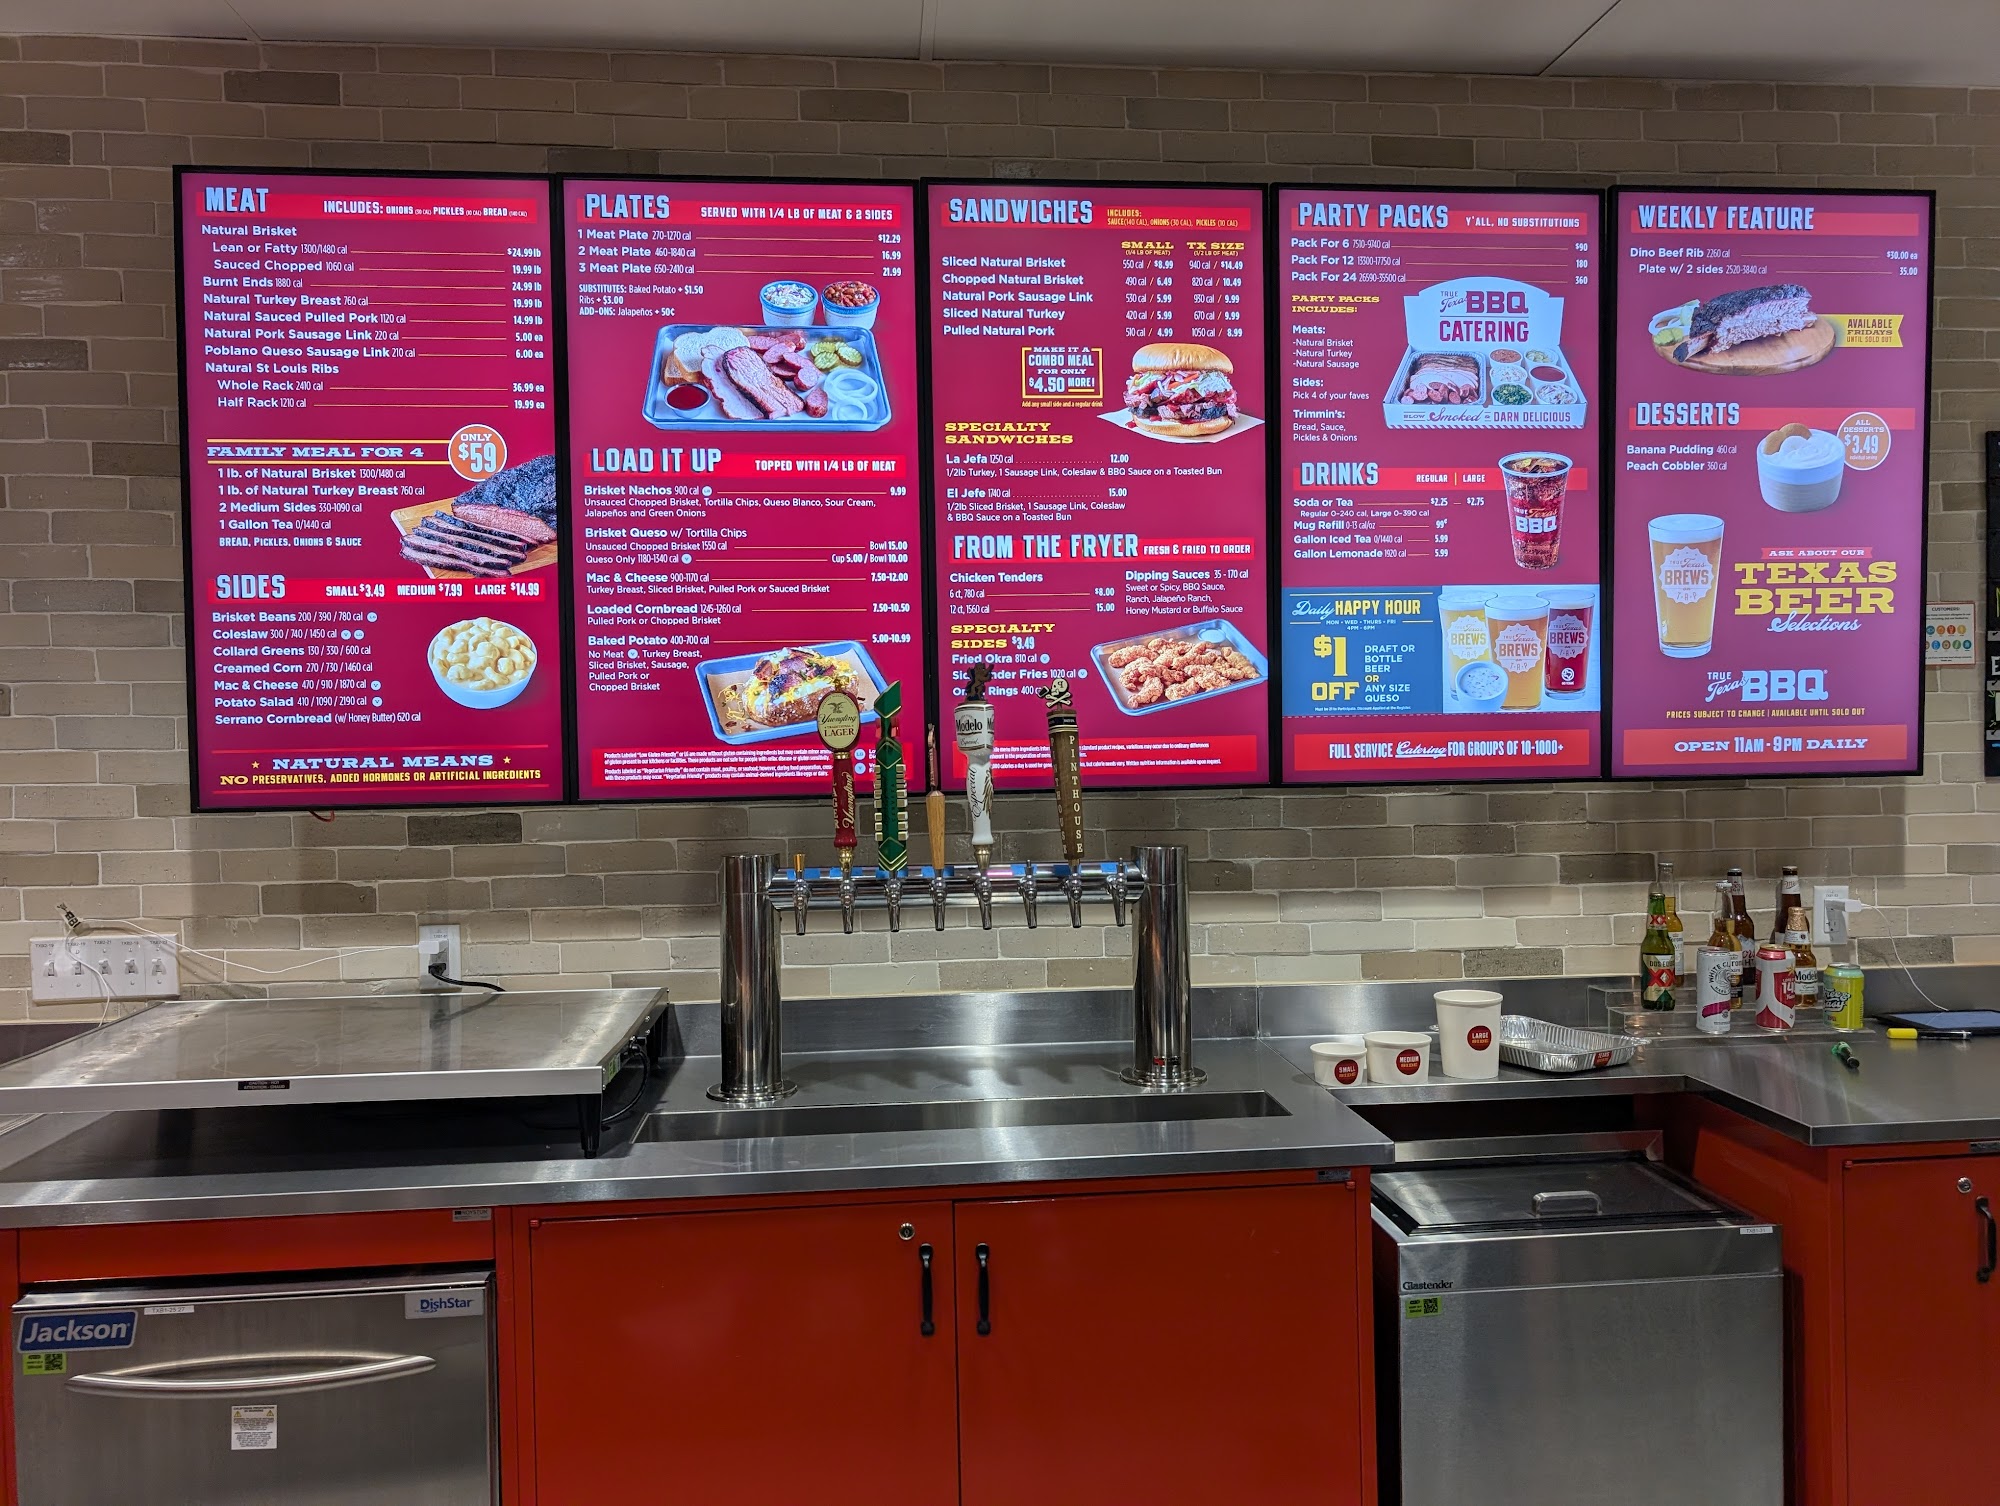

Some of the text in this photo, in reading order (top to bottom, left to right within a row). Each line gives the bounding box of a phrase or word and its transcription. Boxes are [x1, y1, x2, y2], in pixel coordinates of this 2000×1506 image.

[205, 187, 268, 212] MEAT
[585, 194, 670, 219] PLATES
[701, 206, 892, 220] SERVED WITH 1/4 LB OF MEAT & 2 SIDES
[949, 199, 1093, 224] SANDWICHES
[1299, 202, 1448, 228] PARTY PACKS
[1638, 205, 1814, 230] WEEKLY FEATURE
[202, 224, 297, 236] Natural Brisket
[1498, 217, 1509, 227] NO
[1512, 217, 1580, 228] SUBSTITUTIONS
[578, 229, 901, 244] 1 Meat Plate 270-1270 cal $12.29
[1187, 242, 1205, 250] TX
[1211, 242, 1244, 250] SIZE
[1630, 247, 1703, 258] Dino Beef Rib
[1291, 255, 1588, 268] Pack For 12 180
[203, 277, 542, 292] Burnt Ends 1880 cal 24.99 lb
[942, 274, 1083, 286] Chopped Natural Brisket
[1466, 291, 1528, 313] BBQ
[1847, 318, 1892, 329] AVAILABLE
[1440, 321, 1529, 342] CATERING
[1028, 355, 1094, 367] COMBO MEAL
[1029, 377, 1095, 393] $4.50 MORE!
[1494, 411, 1571, 422] DARN DELICIOUS
[1637, 403, 1740, 425] DESSERTS
[945, 423, 1051, 432] SPECIALTY
[461, 434, 492, 442] ONLY
[945, 435, 1073, 444] SANDWICHES
[1844, 434, 1878, 454] $3.49
[208, 447, 424, 458] FAMILY MEAL FOR 4
[458, 442, 496, 472] $59
[1627, 444, 1713, 457] Banana Pudding
[591, 448, 721, 473] LOAD IT UP
[1301, 463, 1379, 486] DRINKS
[1416, 474, 1485, 483] REGULAR LARGE
[584, 485, 906, 496] Brisket Nachos 900 cal 9.99
[954, 534, 1138, 559] FROM THE FRYER
[1144, 544, 1250, 555] FRESH & FRIED TO ORDER
[1734, 561, 1897, 584] TEXAS
[216, 574, 286, 599] SIDES
[326, 583, 539, 597] SMALL $3.49 MEDIUM $7.99 LARGE $14.99
[1292, 600, 1421, 619] Daily HAPPY HOUR
[1734, 588, 1894, 616] BEER
[1767, 611, 1861, 632] Selections
[1314, 635, 1348, 677] $1
[1499, 643, 1538, 657] BREWS
[952, 653, 1012, 664] Fried Okra
[1707, 672, 1732, 680] TRUE
[1312, 682, 1360, 700] OFF
[1705, 677, 1749, 702] Texas
[1741, 669, 1828, 702] BBQ
[824, 728, 855, 737] LAGER
[956, 719, 982, 731] Modelo
[1330, 740, 1563, 759] FULL SERVICE Catering FOR GROUPS OF 10-1000+
[1674, 741, 1730, 752] OPEN
[1734, 737, 1763, 752] 11AM
[1773, 736, 1802, 752] 9PM
[1806, 738, 1868, 749] DAILY
[273, 755, 493, 770] NATURAL MEANS
[220, 776, 248, 785] NO
[330, 772, 360, 783] ADDED
[363, 772, 411, 782] HORMONES
[414, 772, 426, 781] OR
[429, 771, 480, 781] ARTIFICIAL
[483, 769, 541, 780] INGREDIENTS
[1069, 736, 1083, 853] PINTHOUSE
[1339, 1066, 1355, 1074] SMALL
[1403, 1280, 1453, 1290] Glastender
[420, 1298, 475, 1309] DishStar
[24, 1320, 130, 1343] Jackson
